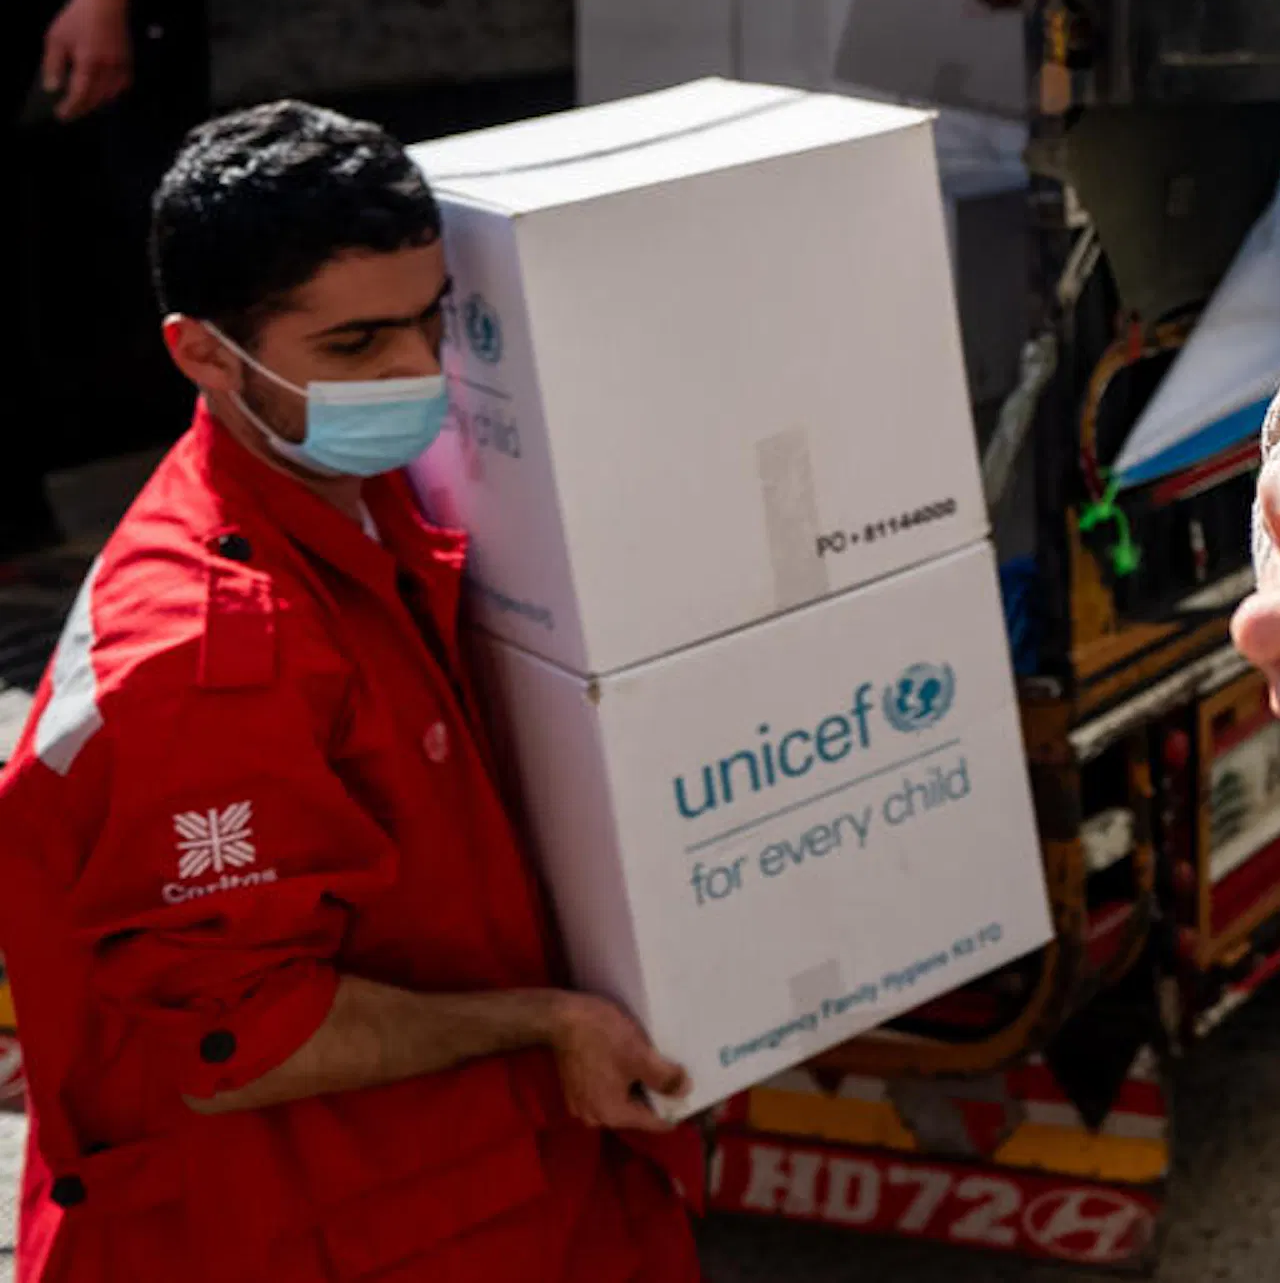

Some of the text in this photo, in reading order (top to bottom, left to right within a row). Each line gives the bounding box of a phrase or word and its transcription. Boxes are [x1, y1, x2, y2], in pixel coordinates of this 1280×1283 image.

[673, 682, 873, 819] unicef
[690, 755, 971, 906] for every child
[742, 1146, 1023, 1247] HD72
